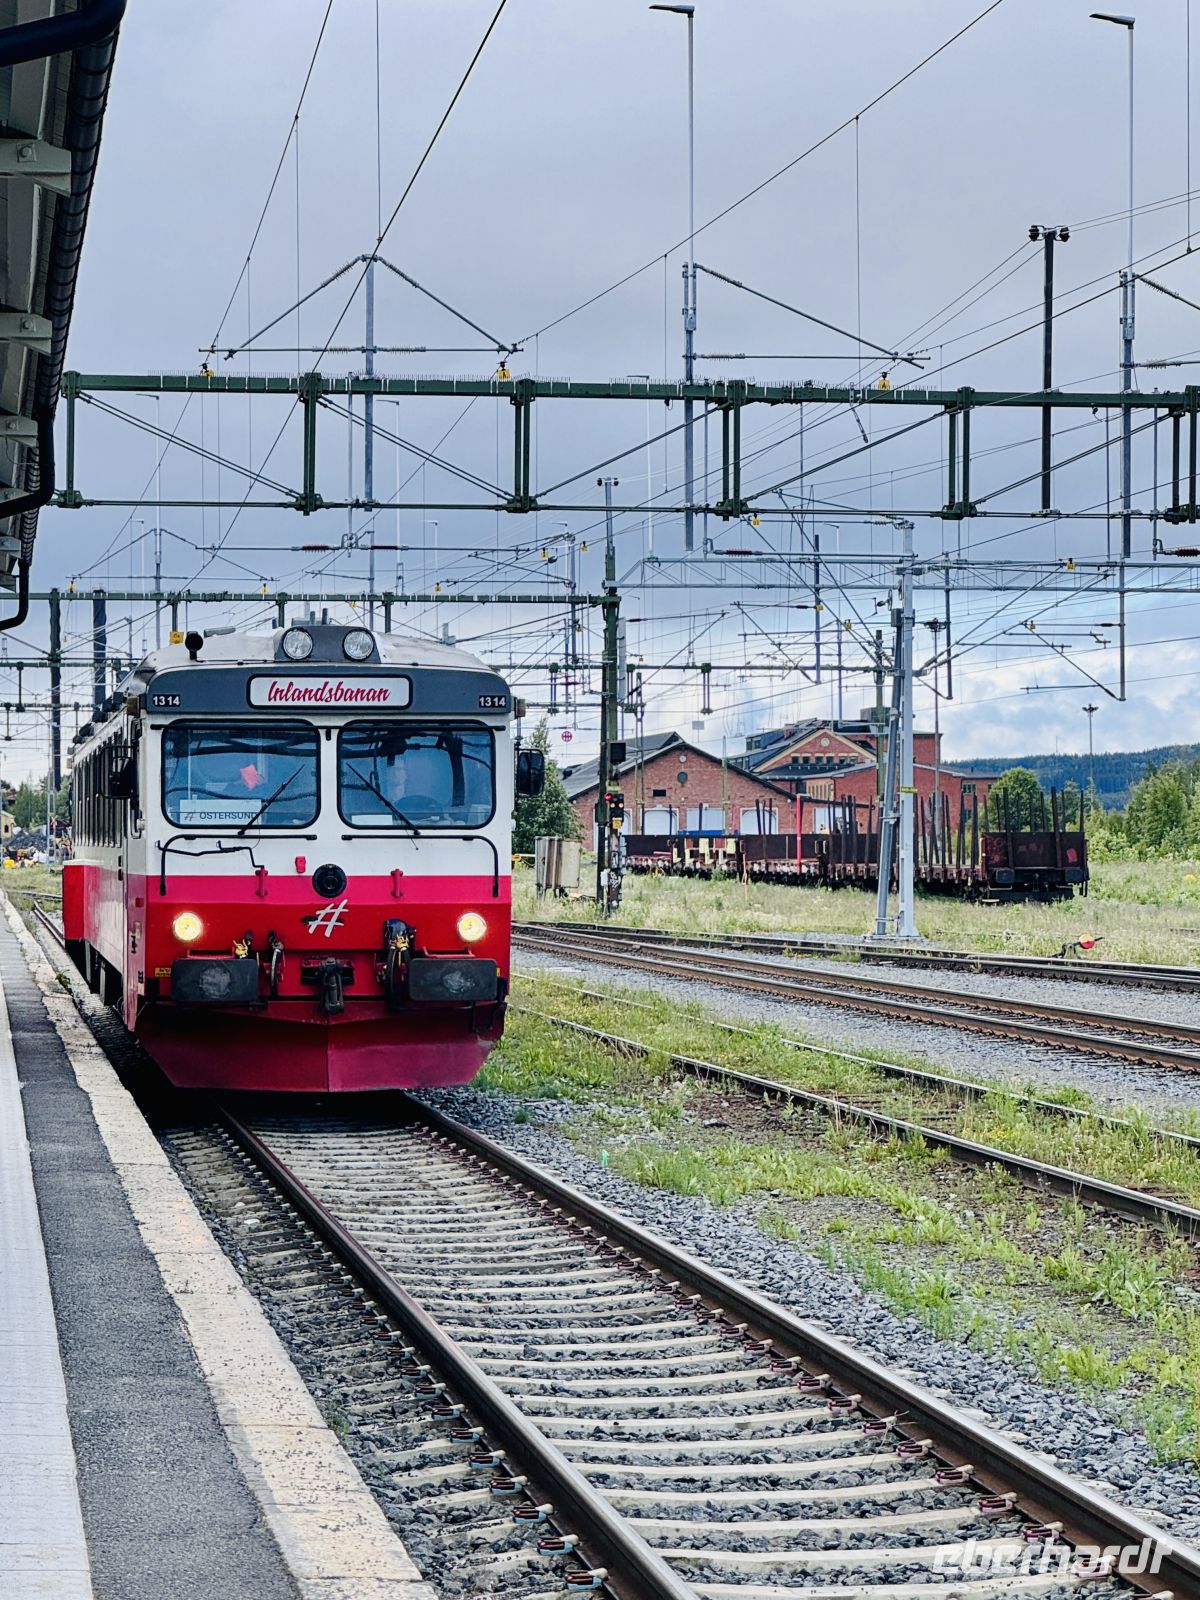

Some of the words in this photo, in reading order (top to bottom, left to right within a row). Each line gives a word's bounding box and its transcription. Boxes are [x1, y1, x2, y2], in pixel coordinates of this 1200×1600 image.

[267, 680, 391, 703] Inlandsbanan
[153, 695, 180, 706] 1314
[479, 696, 506, 707] 1314
